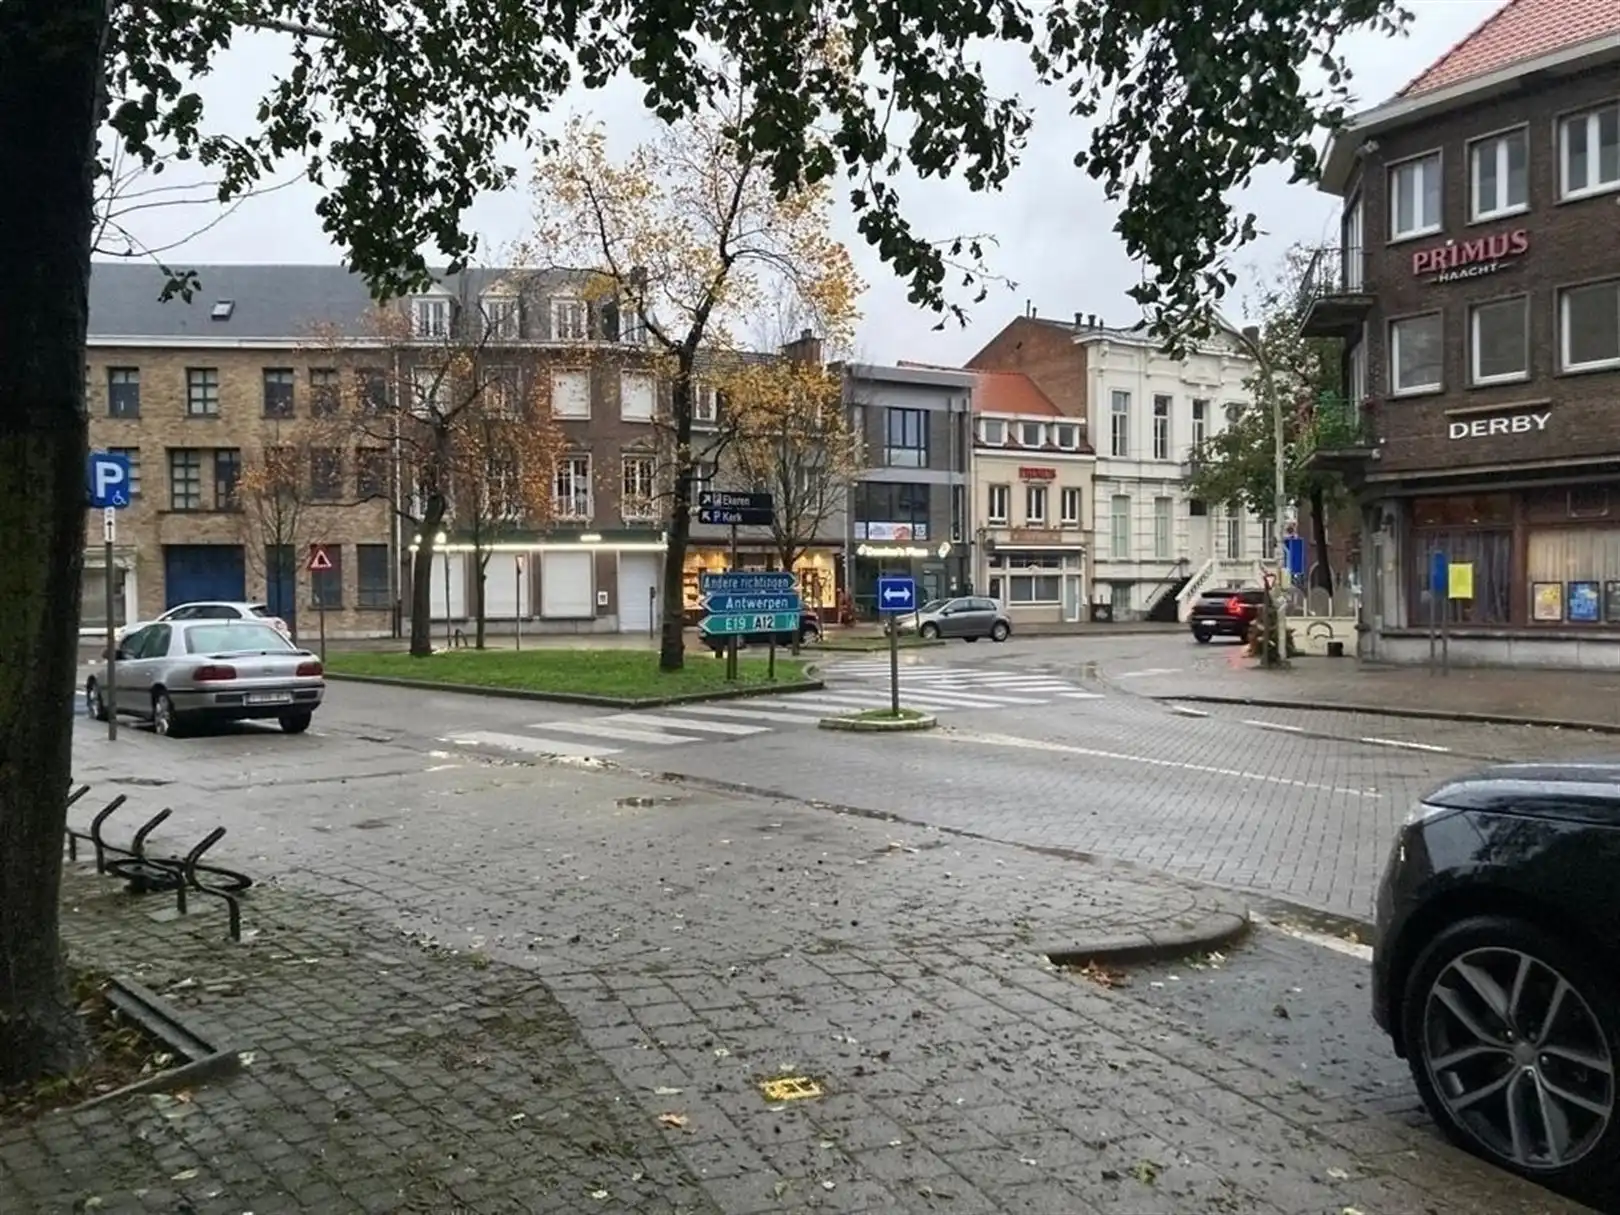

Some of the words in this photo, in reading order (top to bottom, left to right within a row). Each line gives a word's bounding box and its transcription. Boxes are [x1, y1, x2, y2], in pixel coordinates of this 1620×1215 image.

[1413, 229, 1528, 275] PRIMUS
[1439, 262, 1498, 283] HAACHT
[1449, 412, 1552, 439] DERBY
[96, 461, 124, 498] P
[704, 576, 738, 589] Andere
[740, 576, 789, 590] richtingen
[726, 597, 789, 609] Antwerpen
[725, 617, 746, 630] E19
[755, 615, 774, 629] A12
